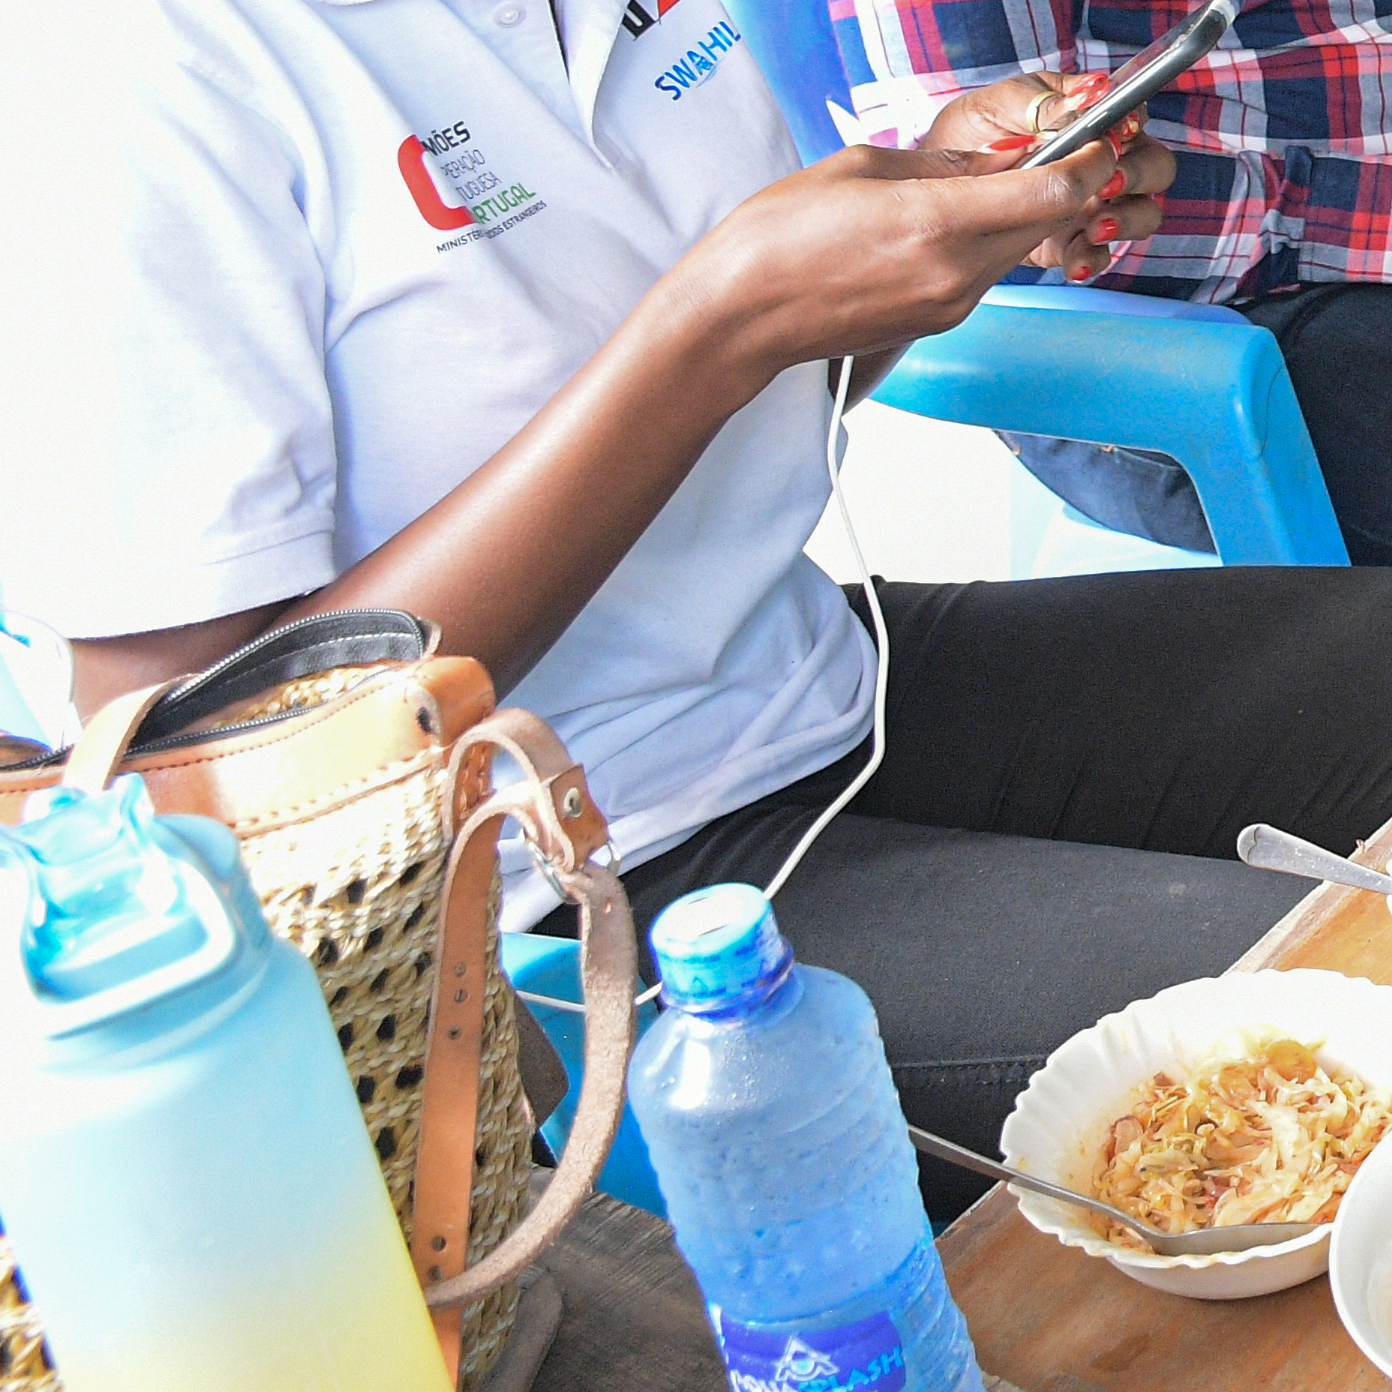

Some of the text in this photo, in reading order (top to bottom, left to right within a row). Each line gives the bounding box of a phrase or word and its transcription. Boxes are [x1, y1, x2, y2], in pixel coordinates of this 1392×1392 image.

[653, 20, 742, 102] SWAHIL
[420, 120, 472, 157] MÕES
[455, 171, 503, 202] TUGUESA
[471, 182, 537, 225] RTUGAL
